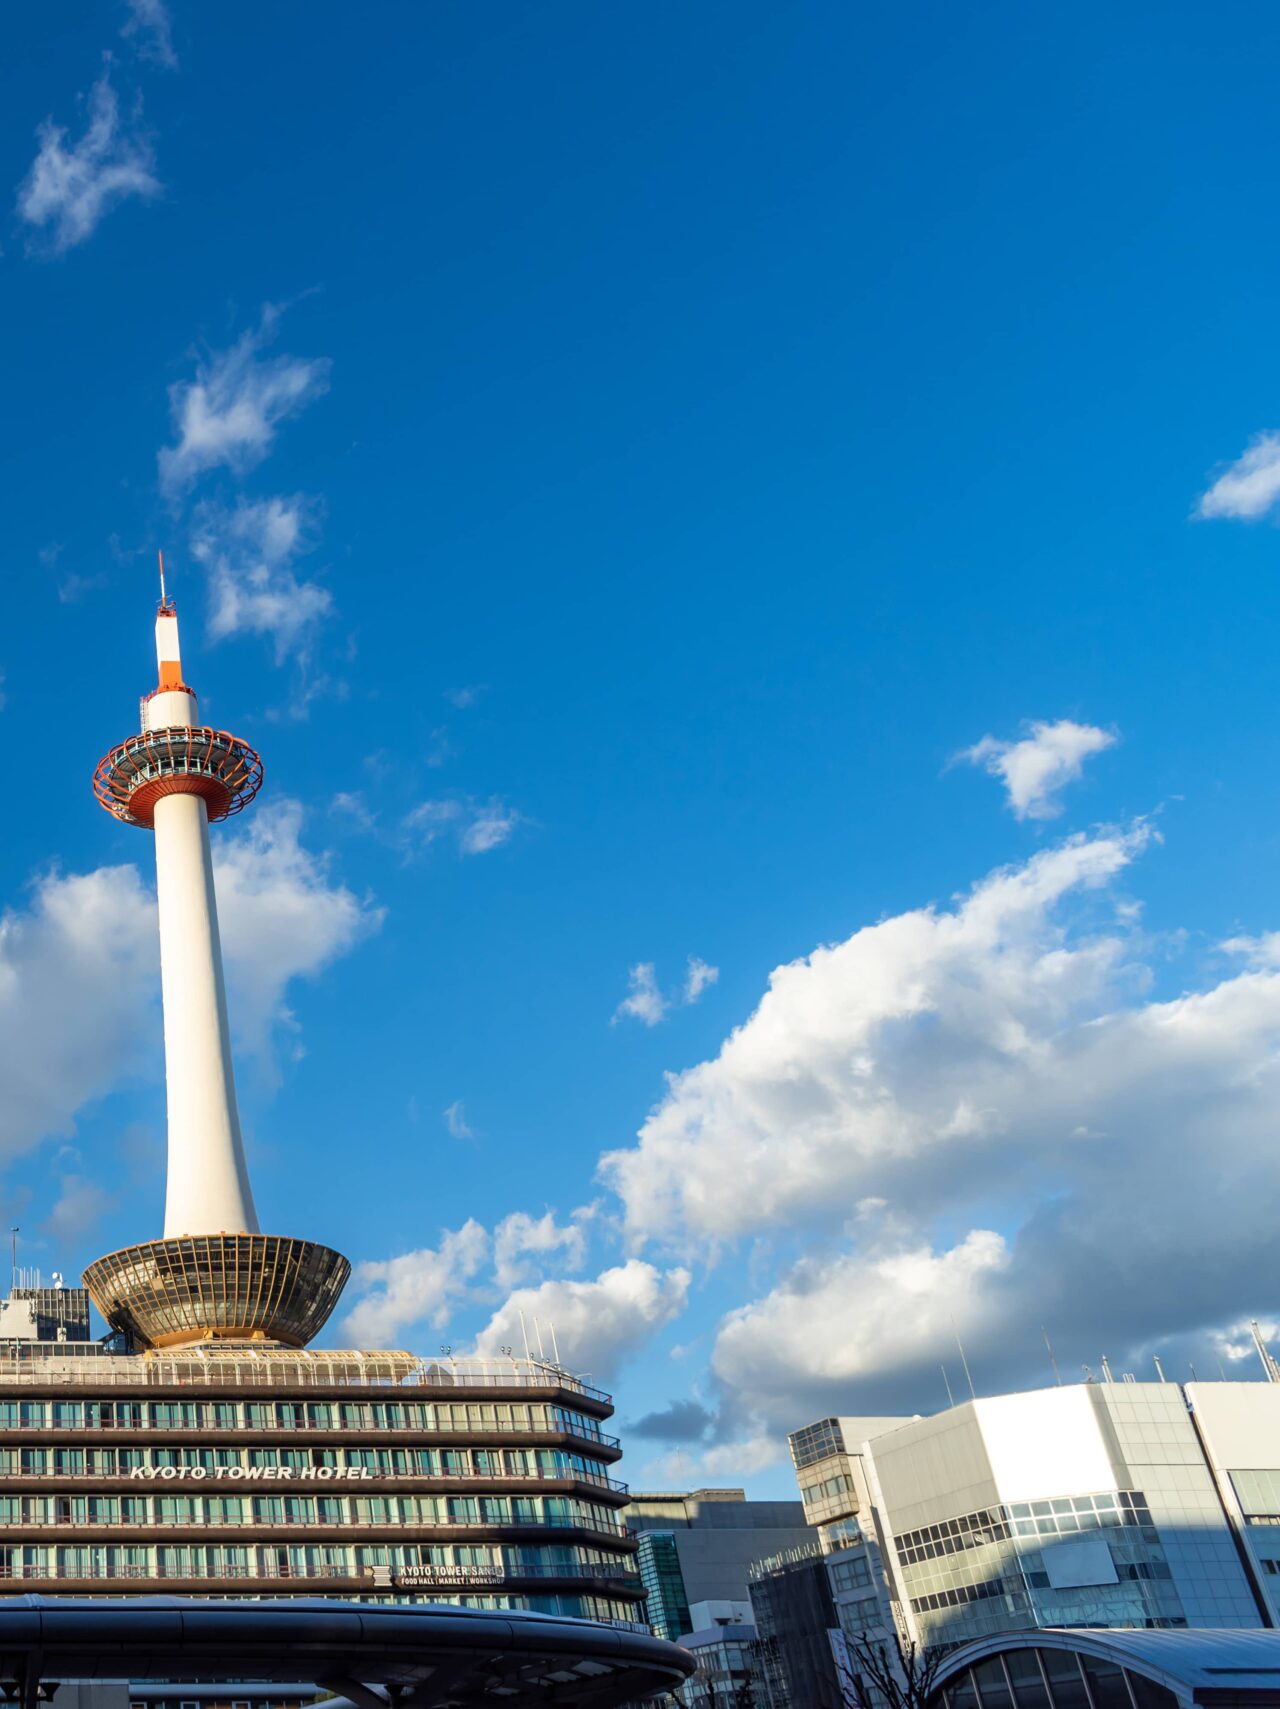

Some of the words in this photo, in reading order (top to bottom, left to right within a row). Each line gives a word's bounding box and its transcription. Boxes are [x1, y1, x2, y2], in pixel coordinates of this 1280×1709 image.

[130, 1466, 207, 1479] KYOTO
[214, 1466, 292, 1479] TOWER
[300, 1466, 373, 1479] HOTEL
[400, 1566, 432, 1576] KYOTO
[434, 1566, 468, 1576] TOWER
[401, 1577, 417, 1585] FOOD
[418, 1577, 434, 1585] HALL
[439, 1577, 464, 1585] MARKET
